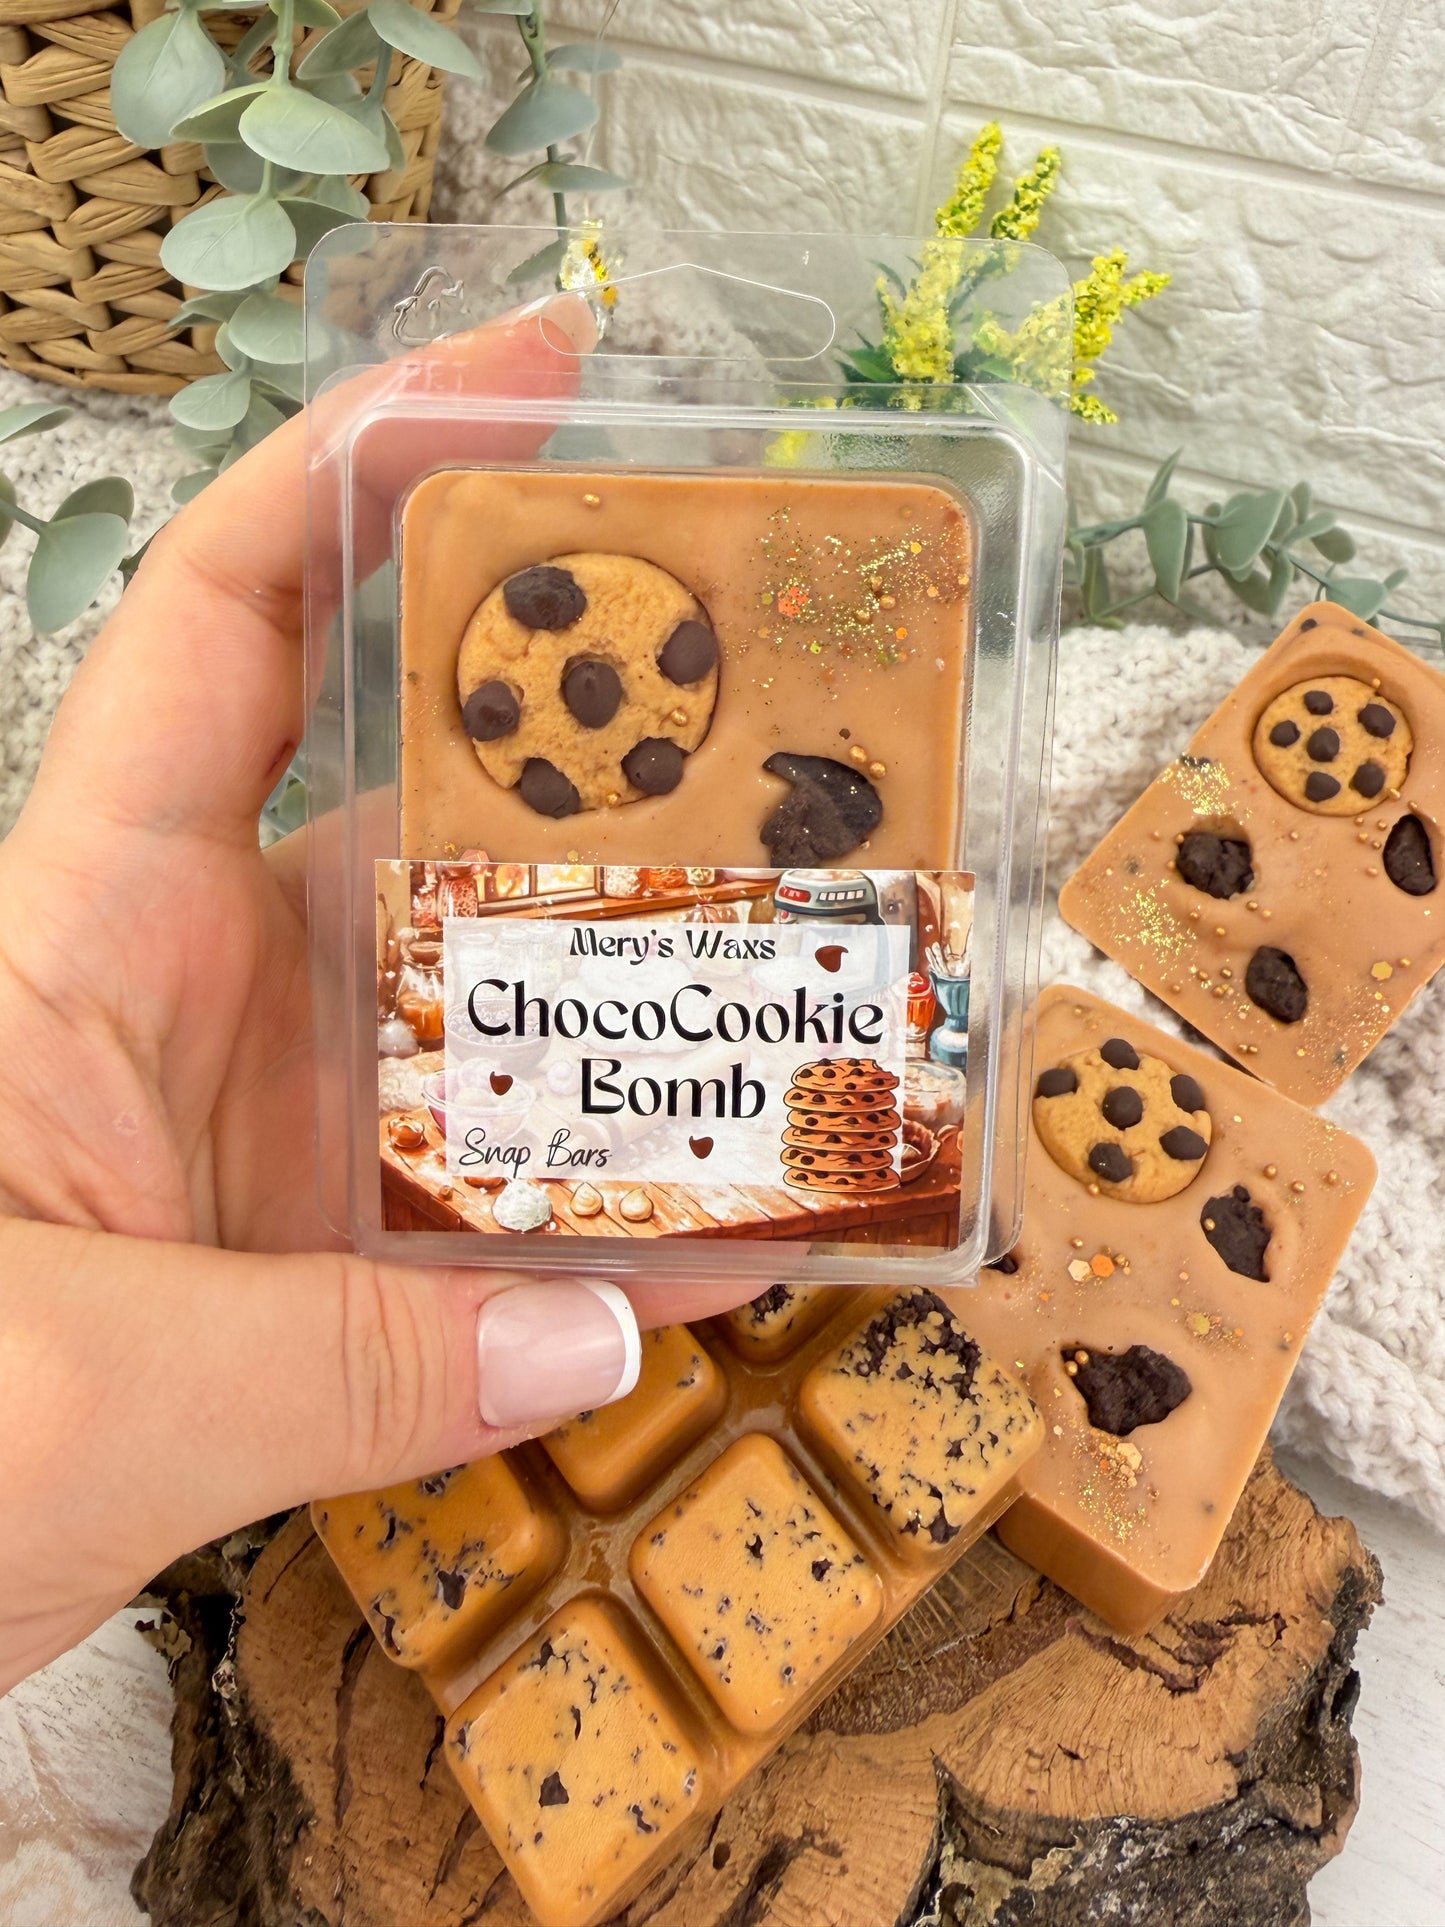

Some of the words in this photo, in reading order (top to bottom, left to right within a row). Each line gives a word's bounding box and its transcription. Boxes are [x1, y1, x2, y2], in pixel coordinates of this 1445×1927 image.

[570, 927, 674, 965] Mery's
[686, 930, 776, 960] Waxs
[467, 978, 884, 1044] ChocoCookie
[581, 1058, 766, 1118] Bomb
[458, 1127, 532, 1180] Snap
[545, 1129, 611, 1168] Bars
